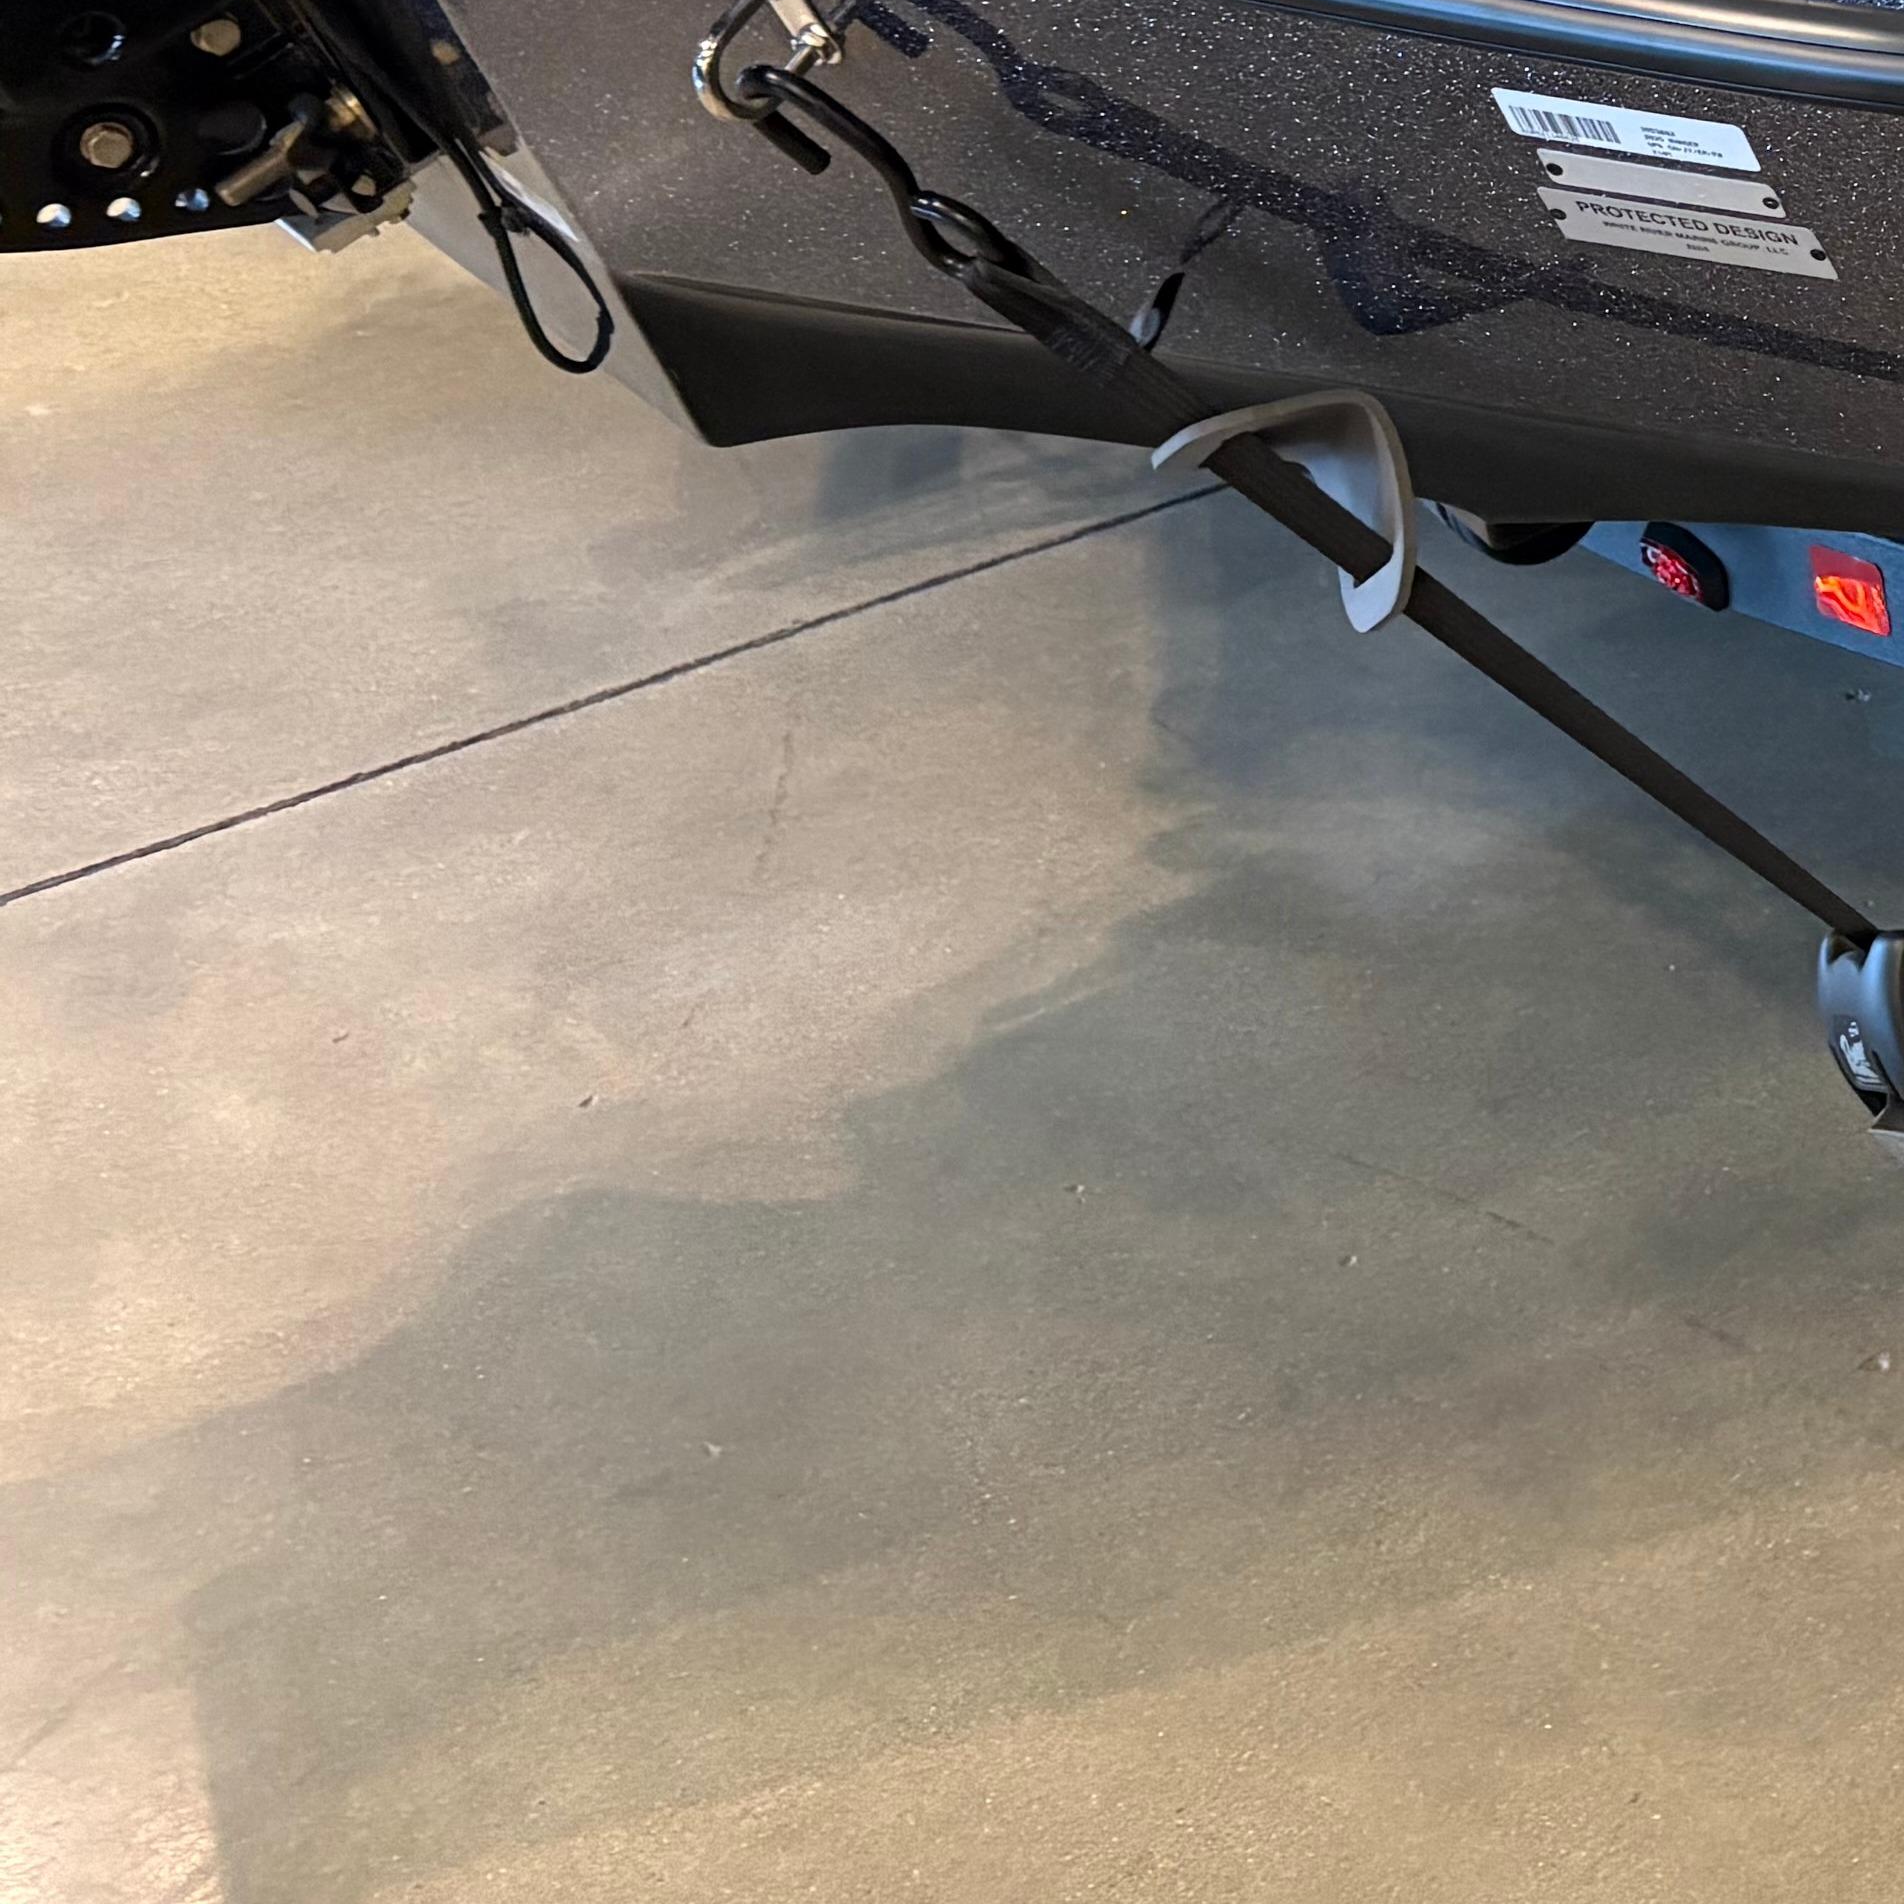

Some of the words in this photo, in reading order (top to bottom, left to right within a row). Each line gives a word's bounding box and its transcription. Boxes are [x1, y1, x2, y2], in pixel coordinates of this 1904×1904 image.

[1575, 200, 1709, 232] PROTECTED
[1713, 222, 1799, 246] DESIGN
[1602, 221, 1638, 233] WHITE
[1675, 232, 1717, 245] MARINE
